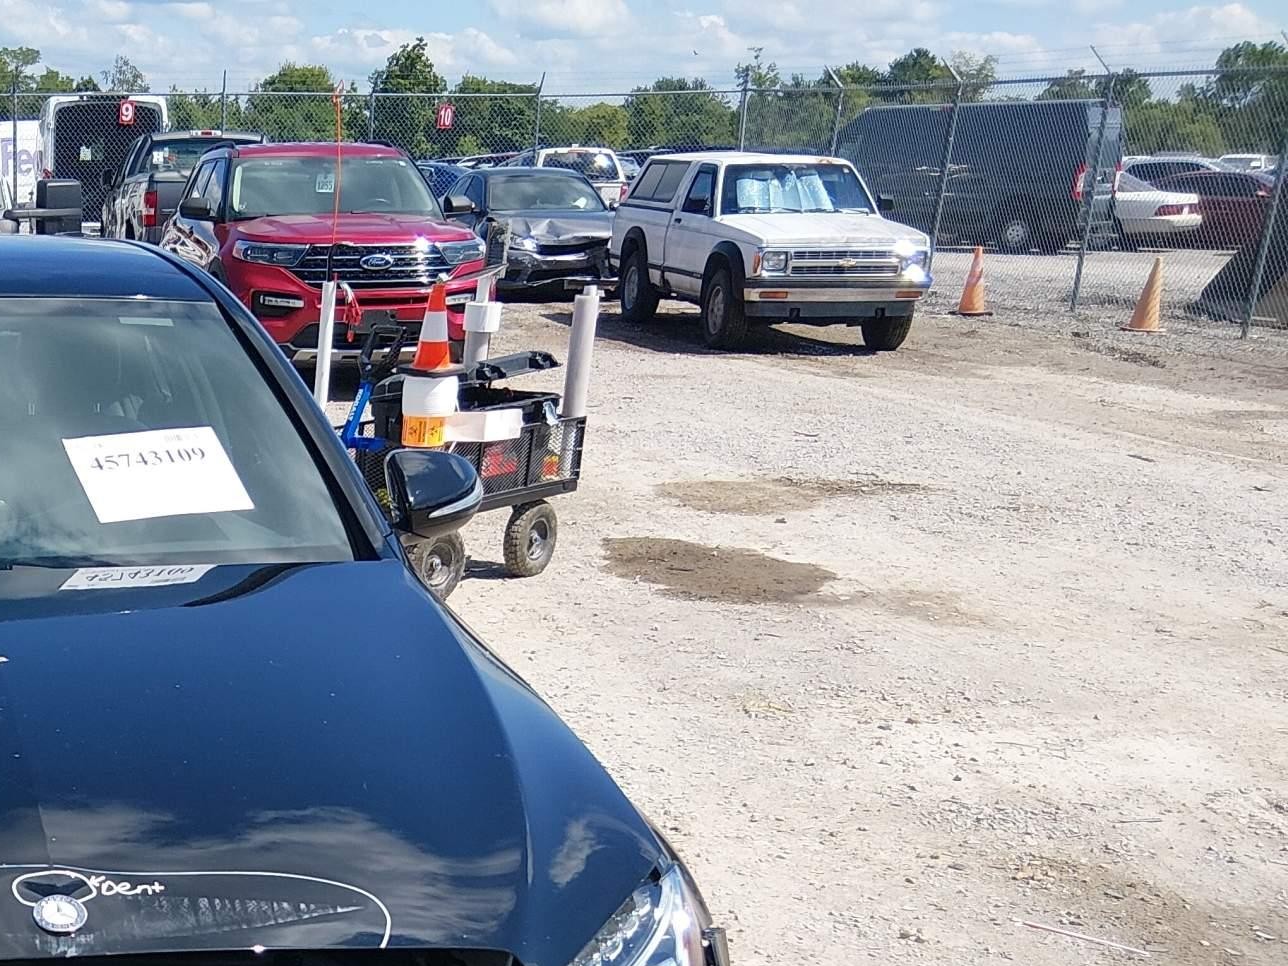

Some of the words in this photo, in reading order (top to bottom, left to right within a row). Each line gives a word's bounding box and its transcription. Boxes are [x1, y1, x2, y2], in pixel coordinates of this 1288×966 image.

[121, 103, 133, 121] 9
[439, 107, 452, 126] 10
[90, 447, 206, 471] 45743109
[101, 879, 166, 896] Dent
